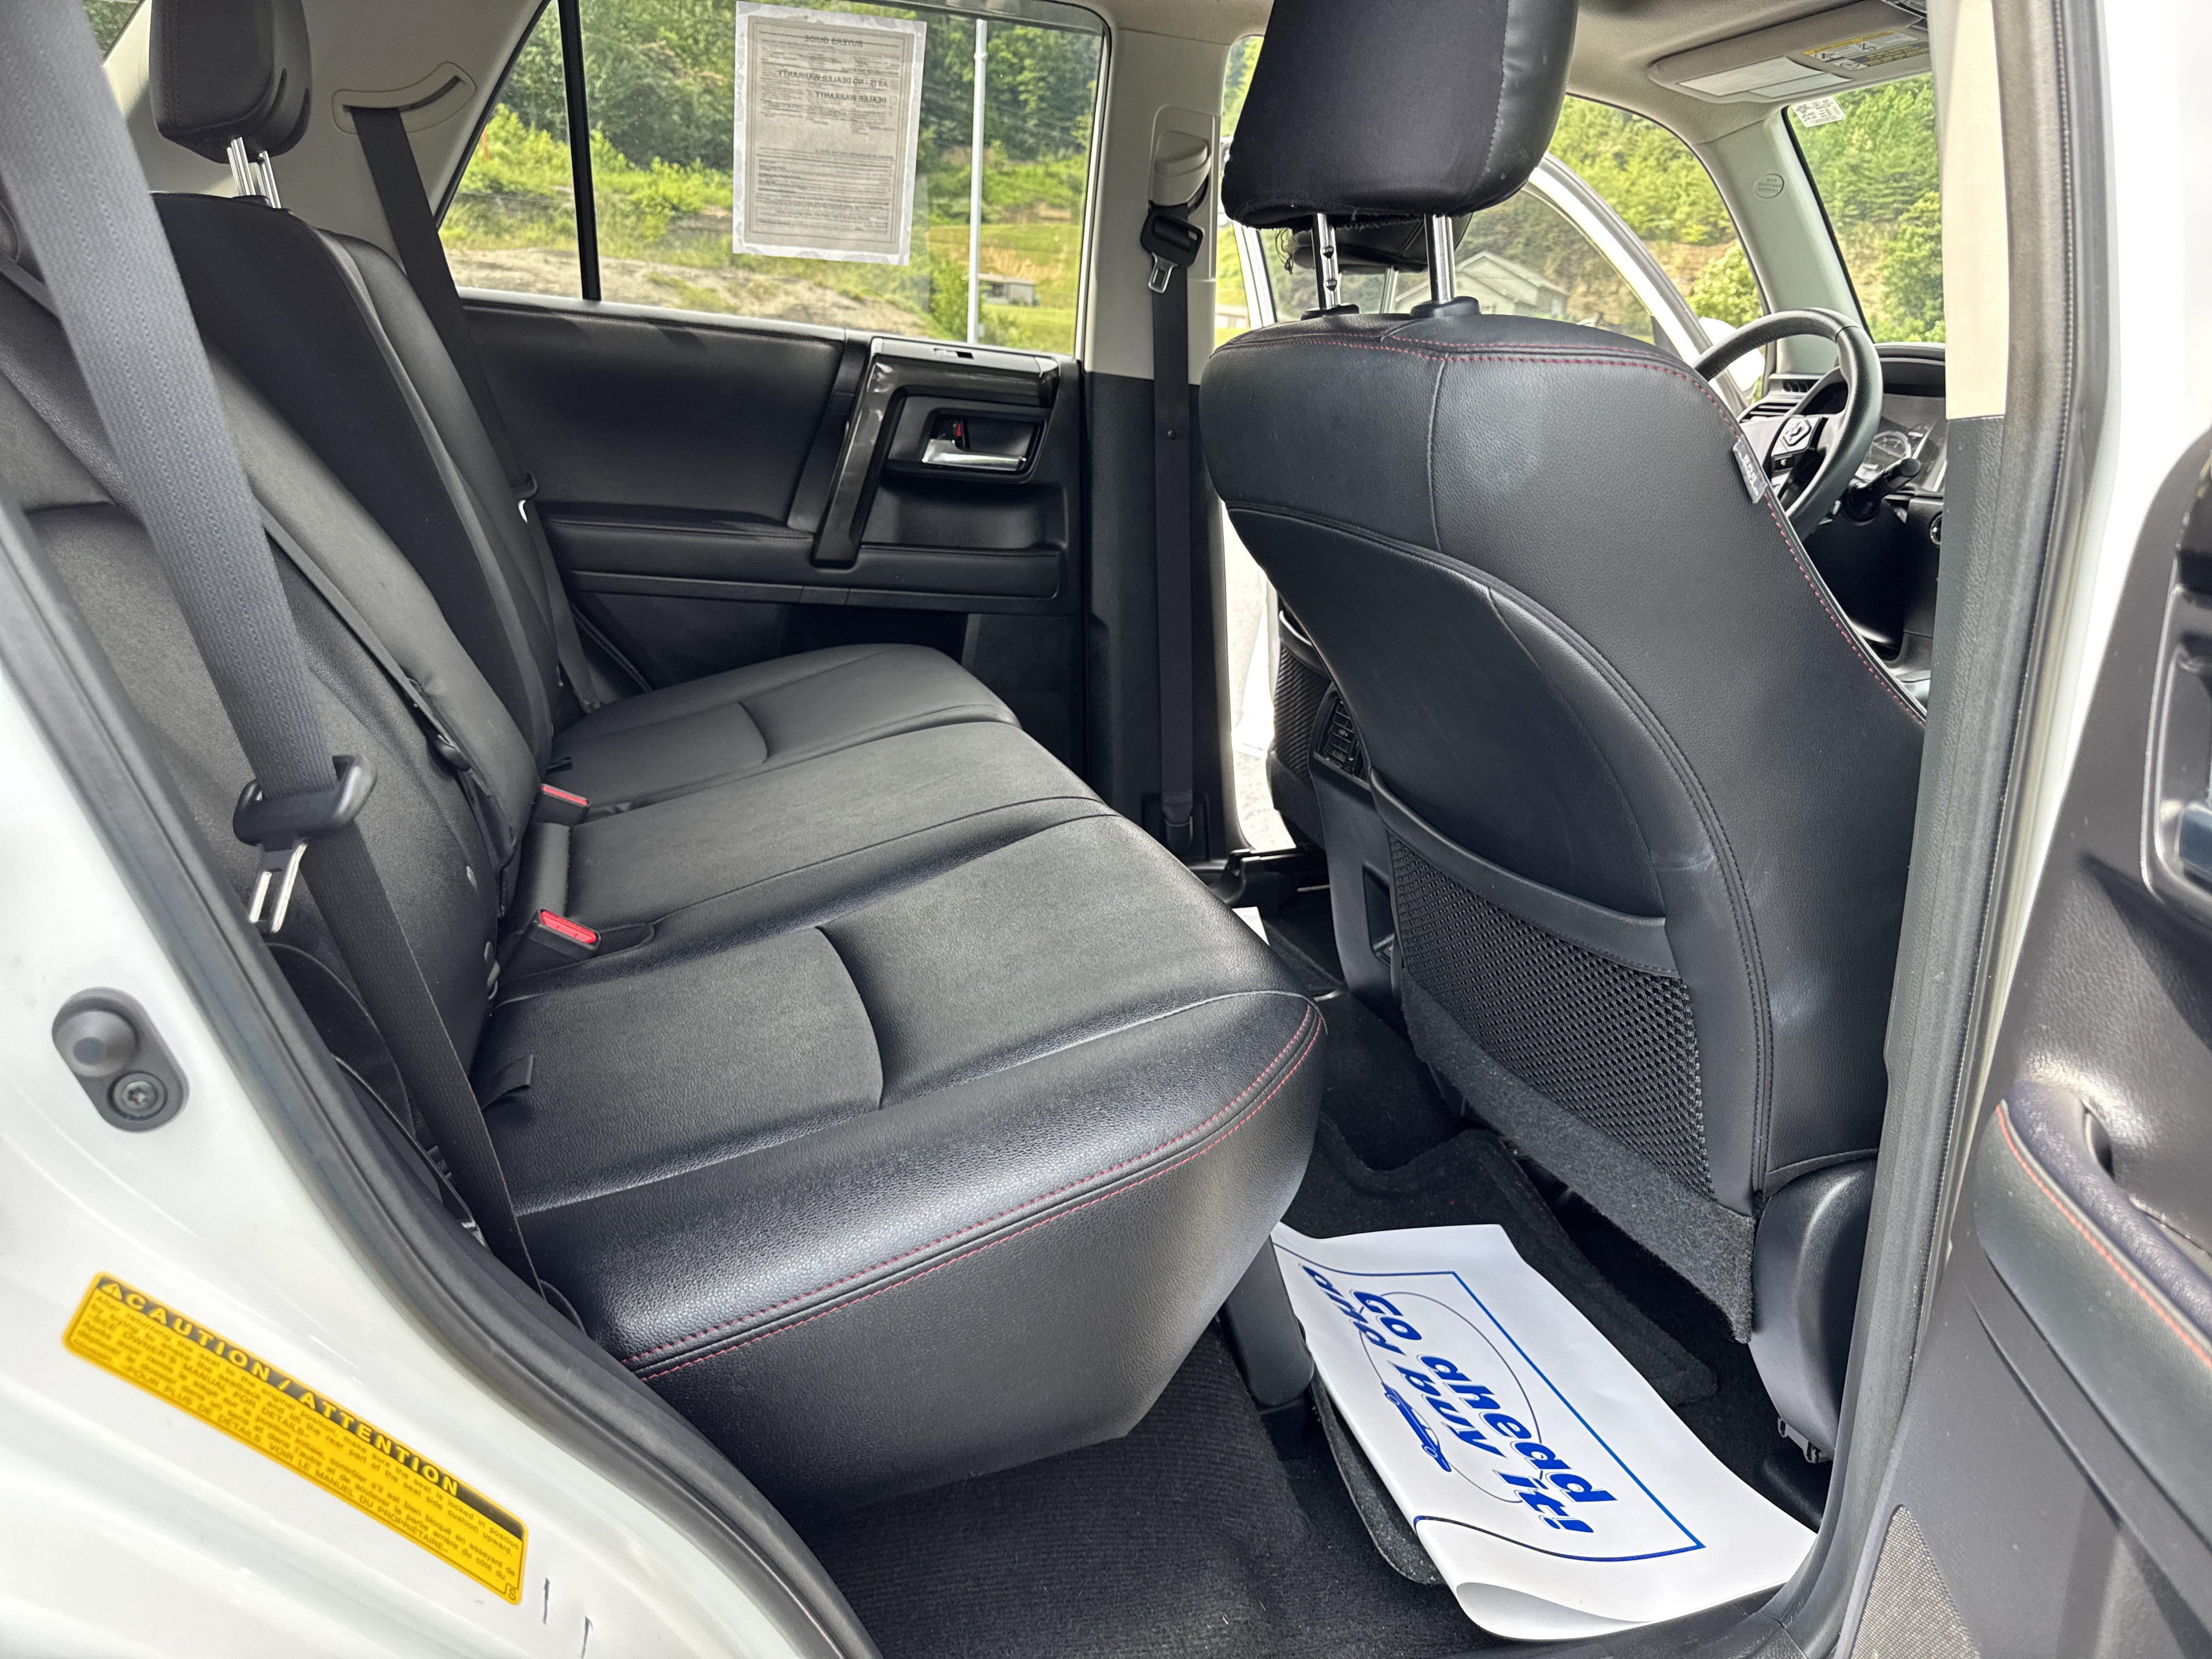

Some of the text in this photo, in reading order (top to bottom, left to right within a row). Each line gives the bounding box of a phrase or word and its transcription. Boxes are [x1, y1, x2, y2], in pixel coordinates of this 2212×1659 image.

[126, 1291, 460, 1497] CAUTION / ATTENTION
[145, 1332, 156, 1342] to
[161, 1340, 191, 1362] shake
[196, 1360, 213, 1374] the
[218, 1372, 261, 1402] seatback
[266, 1399, 285, 1414] and
[289, 1412, 302, 1424] lift
[306, 1421, 321, 1436] the
[326, 1434, 344, 1449] rear
[348, 1448, 367, 1464] part
[371, 1460, 380, 1472] of
[385, 1469, 399, 1483] the
[403, 1481, 421, 1497] seat
[426, 1494, 443, 1511] side
[447, 1508, 478, 1533] cushion
[177, 1339, 194, 1353] the
[199, 1351, 221, 1368] seat
[225, 1366, 236, 1377] to
[240, 1374, 256, 1389] the
[261, 1386, 296, 1412] original
[343, 1434, 368, 1454] make
[371, 1452, 391, 1468] sure
[395, 1465, 409, 1480] the
[414, 1477, 431, 1493] seat
[436, 1491, 443, 1502] is
[448, 1498, 473, 1520] locked
[478, 1517, 485, 1528] in
[489, 1525, 519, 1550] position
[182, 1361, 228, 1394] MANUAL
[233, 1390, 256, 1409] FOR
[1298, 1263, 1595, 1534] and buy it!
[1349, 1289, 1618, 1503] Go ahead
